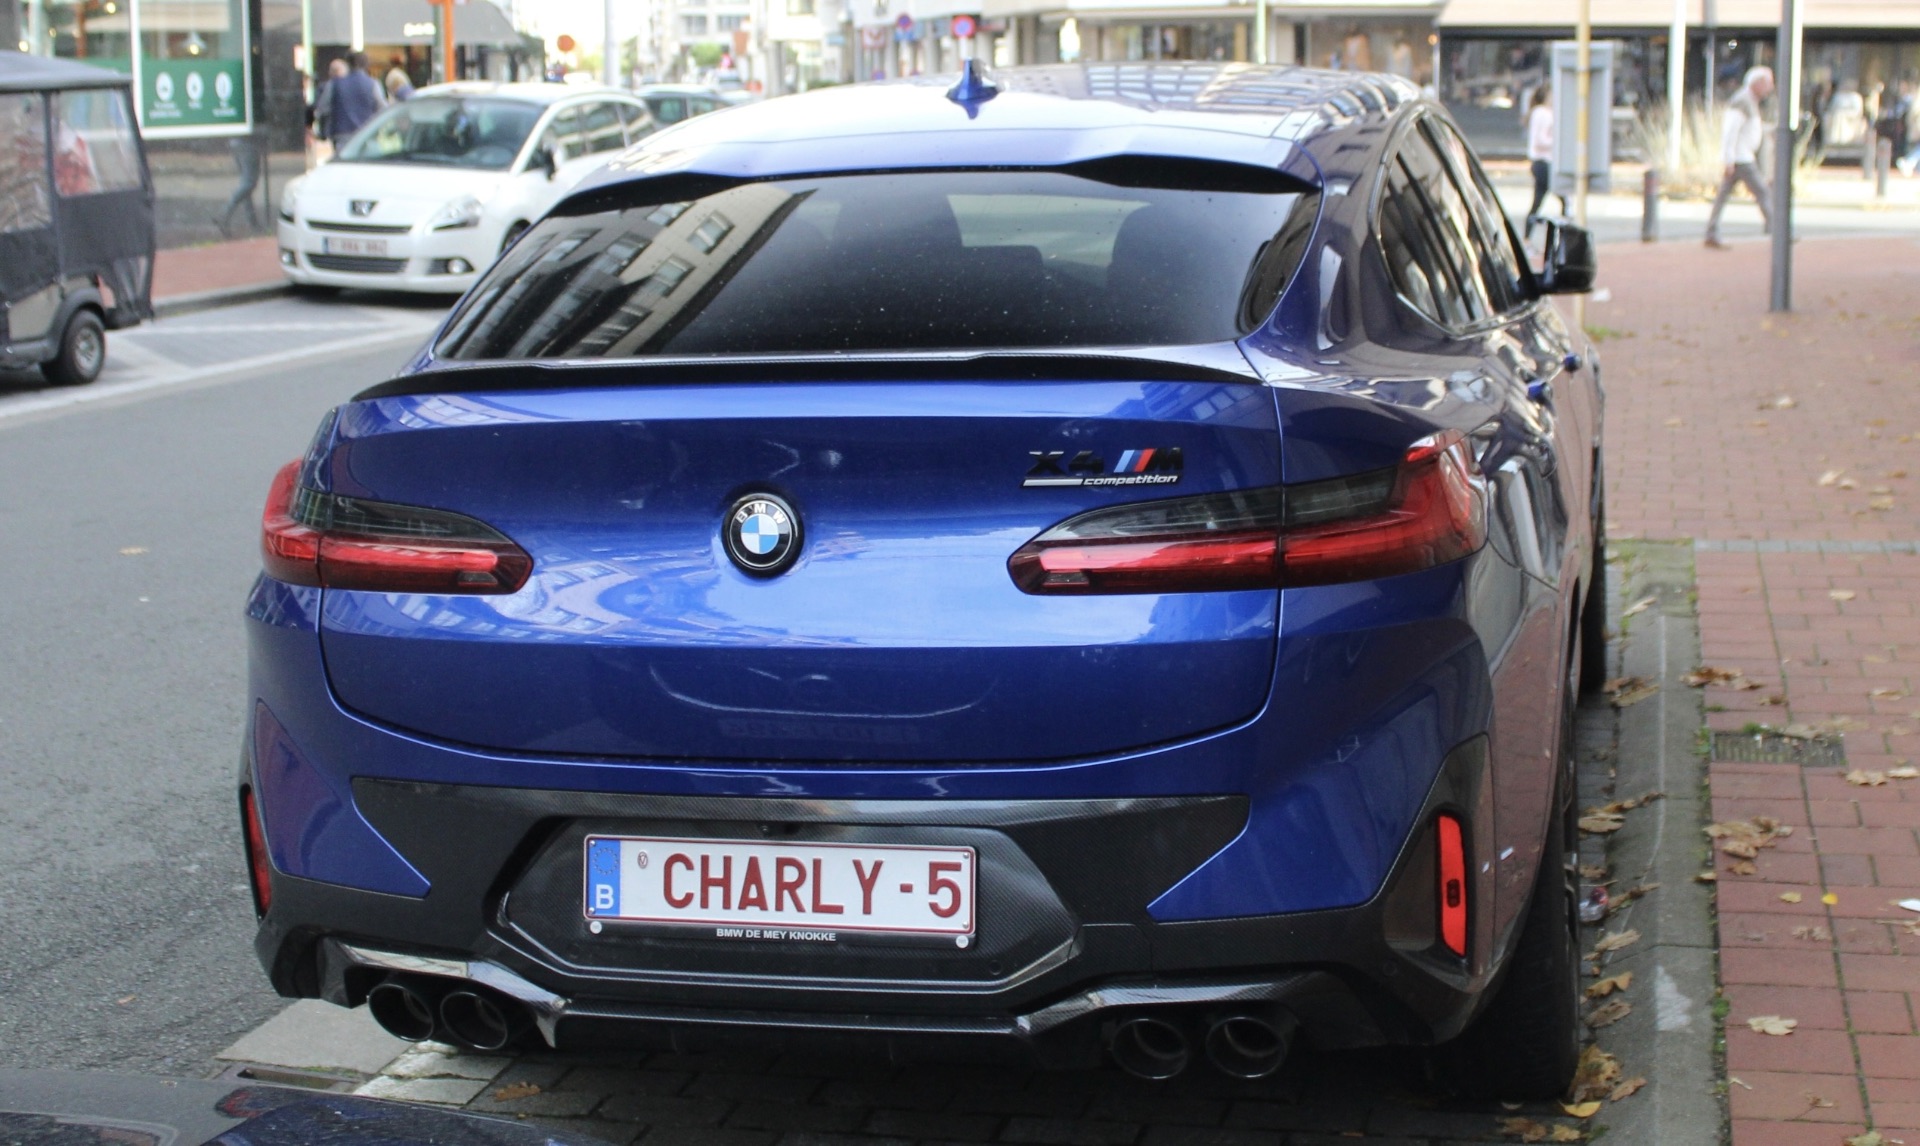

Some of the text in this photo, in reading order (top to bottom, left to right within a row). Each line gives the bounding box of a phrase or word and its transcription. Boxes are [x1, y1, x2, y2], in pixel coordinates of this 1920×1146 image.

[1083, 475, 1178, 486] competition
[735, 503, 786, 524] BMW
[596, 884, 614, 909] B
[716, 928, 837, 942] BMW DE MEY KNOKKE
